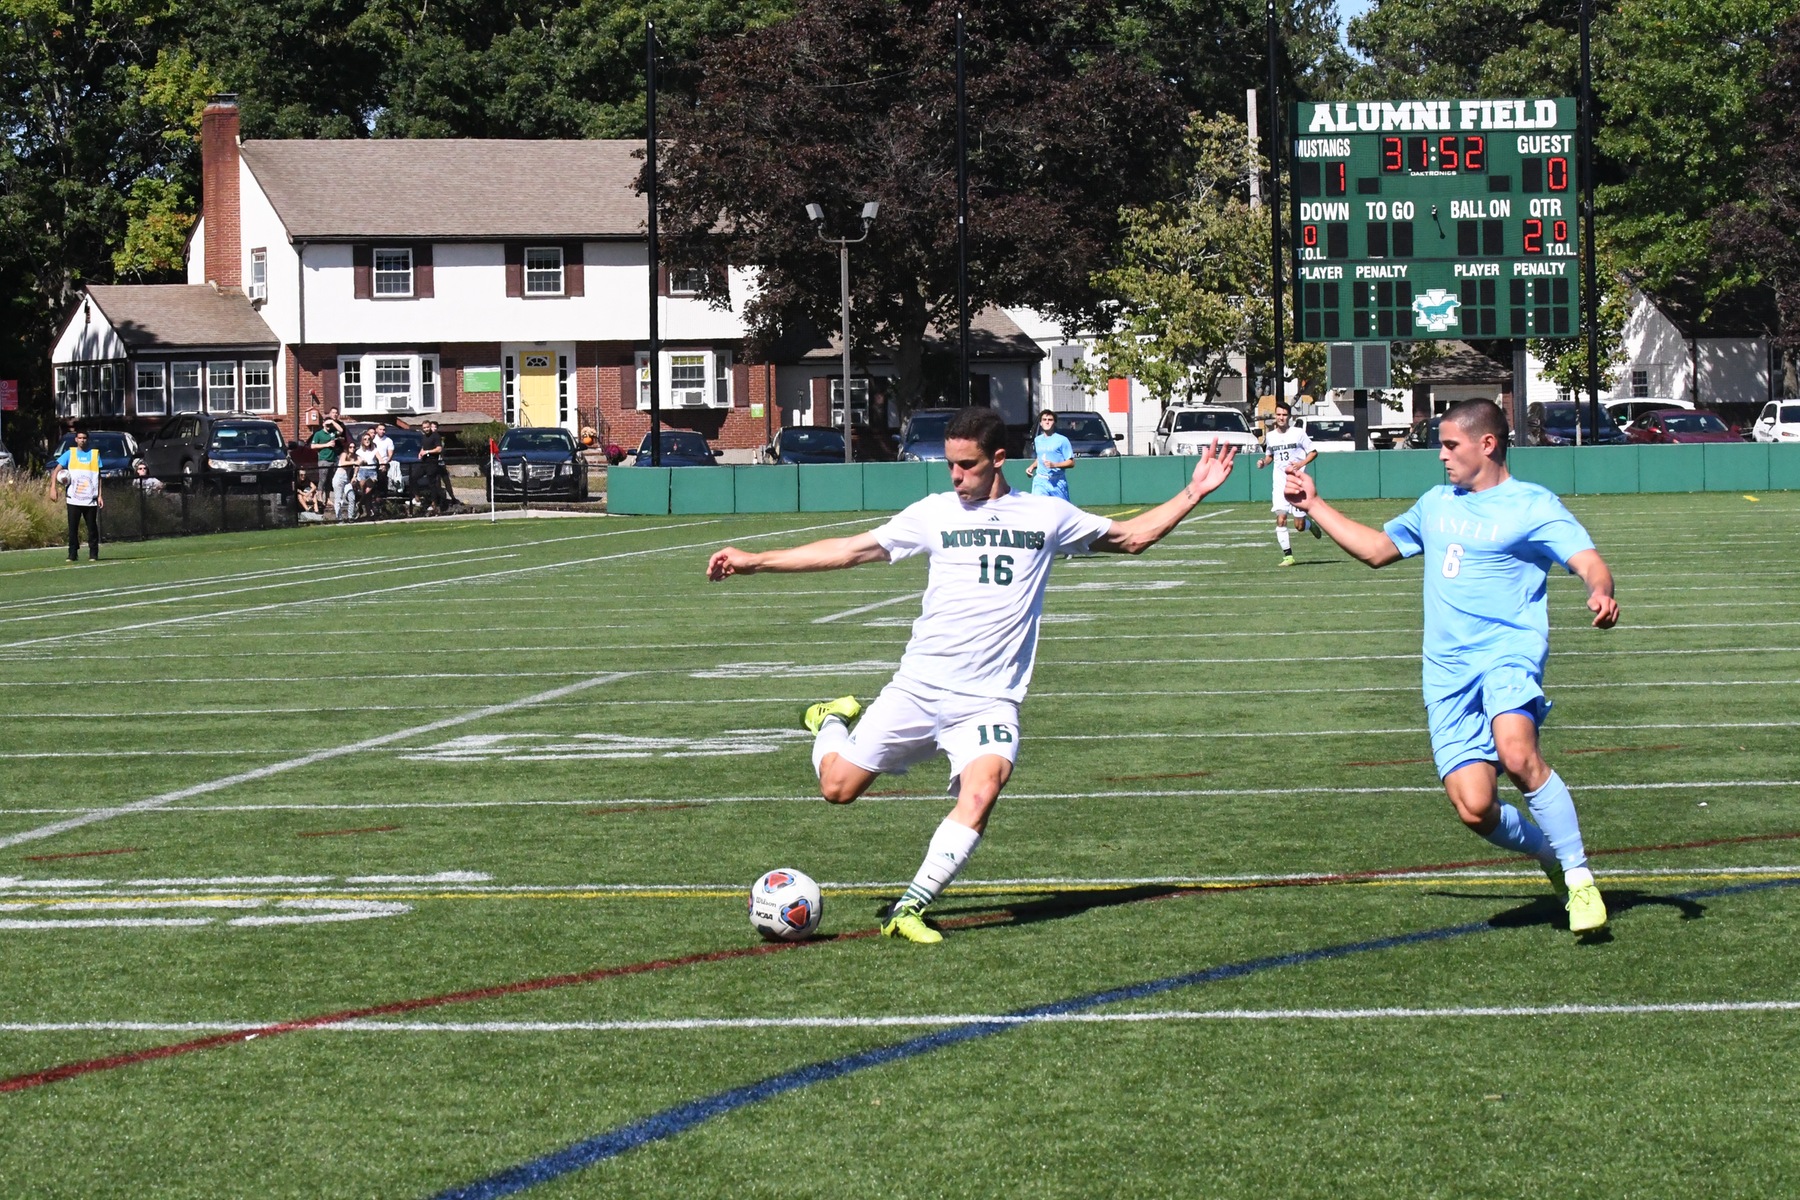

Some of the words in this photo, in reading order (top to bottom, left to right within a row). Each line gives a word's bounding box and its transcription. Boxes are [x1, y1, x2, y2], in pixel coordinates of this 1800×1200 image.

[1309, 101, 1451, 132] ALUMNI
[1459, 100, 1557, 130] FIELD
[1295, 138, 1350, 157] MUSTANGS
[1386, 137, 1483, 170] 31:52
[1517, 135, 1572, 154] GUEST
[1547, 157, 1567, 190] 0
[1300, 202, 1349, 221] DOWN
[1366, 202, 1387, 220] TO
[1392, 201, 1415, 220] GO
[1450, 200, 1487, 219] BALL
[1489, 199, 1511, 218] ON
[1529, 199, 1562, 218] QTR
[1303, 225, 1317, 246] 0
[1524, 219, 1542, 252] 2
[1546, 243, 1577, 256] T.O.L.
[1298, 266, 1342, 279] PLAYER
[1356, 265, 1408, 278] PENALTY
[1454, 263, 1500, 277] PLAYER
[1513, 262, 1565, 276] PENALTY
[1279, 451, 1290, 461] 13
[940, 529, 1045, 550] MUSTANGS
[978, 554, 1014, 586] 16
[1441, 543, 1465, 579] 6
[977, 724, 1012, 746] 16
[756, 896, 777, 908] Wilson
[755, 910, 774, 921] NCAA
